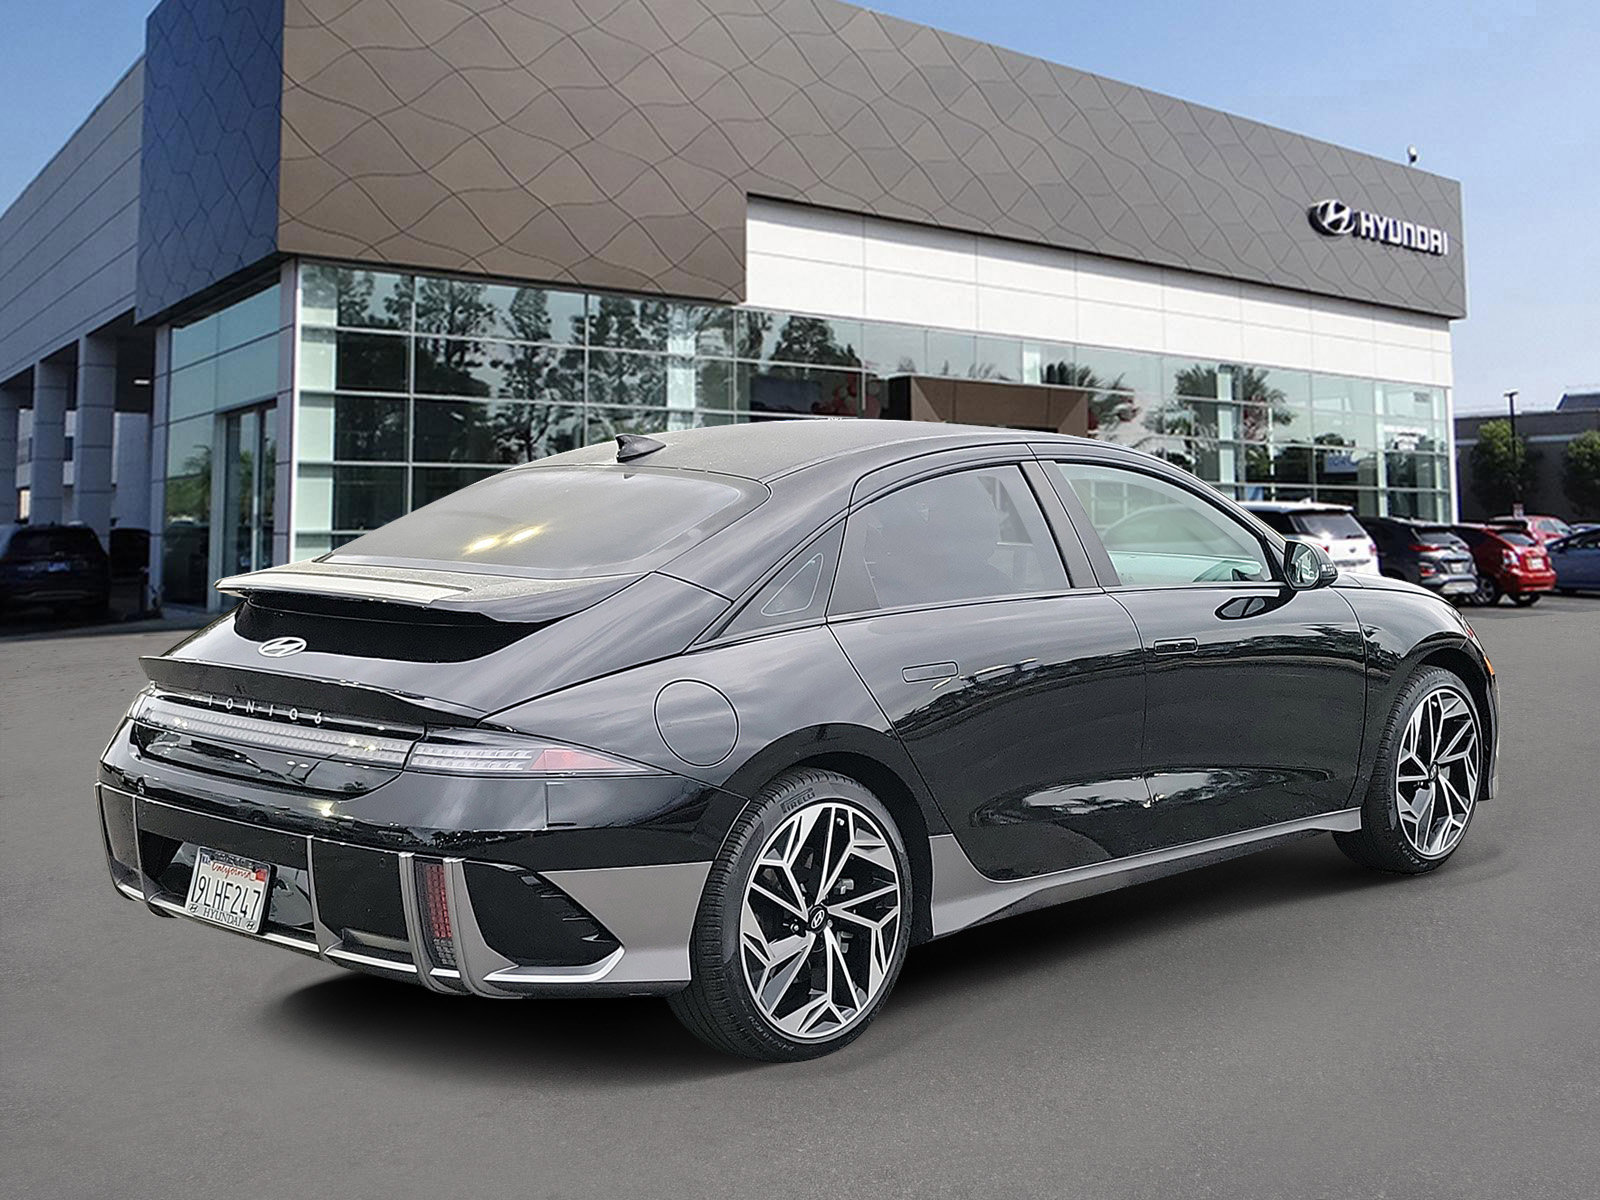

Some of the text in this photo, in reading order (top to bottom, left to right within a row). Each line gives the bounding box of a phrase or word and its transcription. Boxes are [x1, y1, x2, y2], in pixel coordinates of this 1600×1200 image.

[1360, 211, 1448, 255] HYUNDAI
[208, 695, 322, 724] IONIQ 6
[781, 787, 815, 813] PIRELLI
[195, 875, 261, 920] 9LHF247
[203, 907, 242, 926] HYUNDAI
